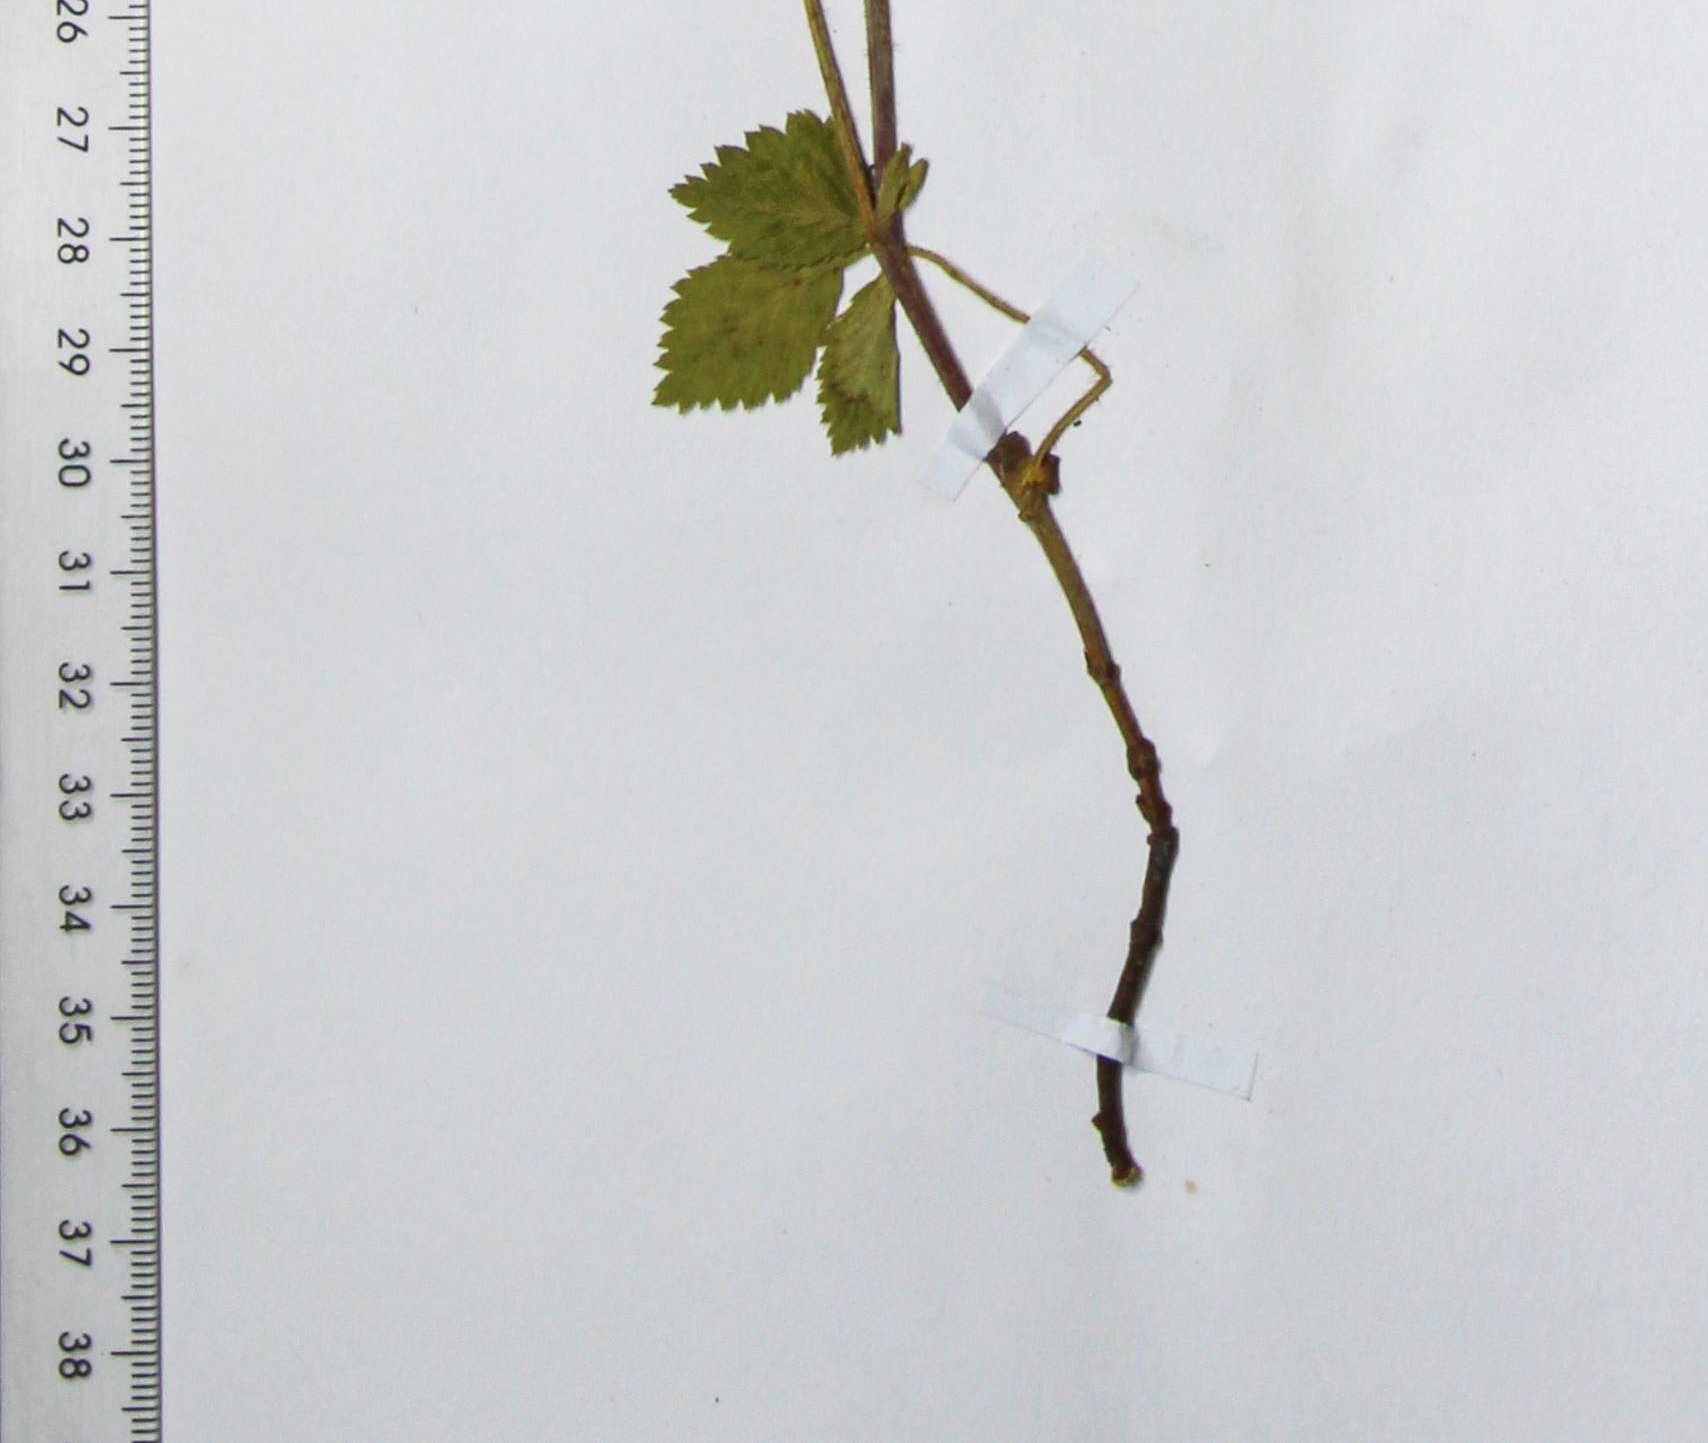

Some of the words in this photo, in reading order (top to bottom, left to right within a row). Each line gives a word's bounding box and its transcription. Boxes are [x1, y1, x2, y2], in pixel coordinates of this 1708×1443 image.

[57, 107, 89, 153] 27
[57, 217, 90, 264] 28
[58, 328, 90, 376] 29
[58, 438, 92, 489] 30
[58, 551, 93, 591] 31
[58, 662, 93, 710] 32
[59, 774, 94, 821] 33
[59, 885, 94, 934] 34
[59, 996, 93, 1045] 35
[58, 1108, 93, 1157] 36
[58, 1220, 93, 1267] 37
[58, 1332, 92, 1381] 38
